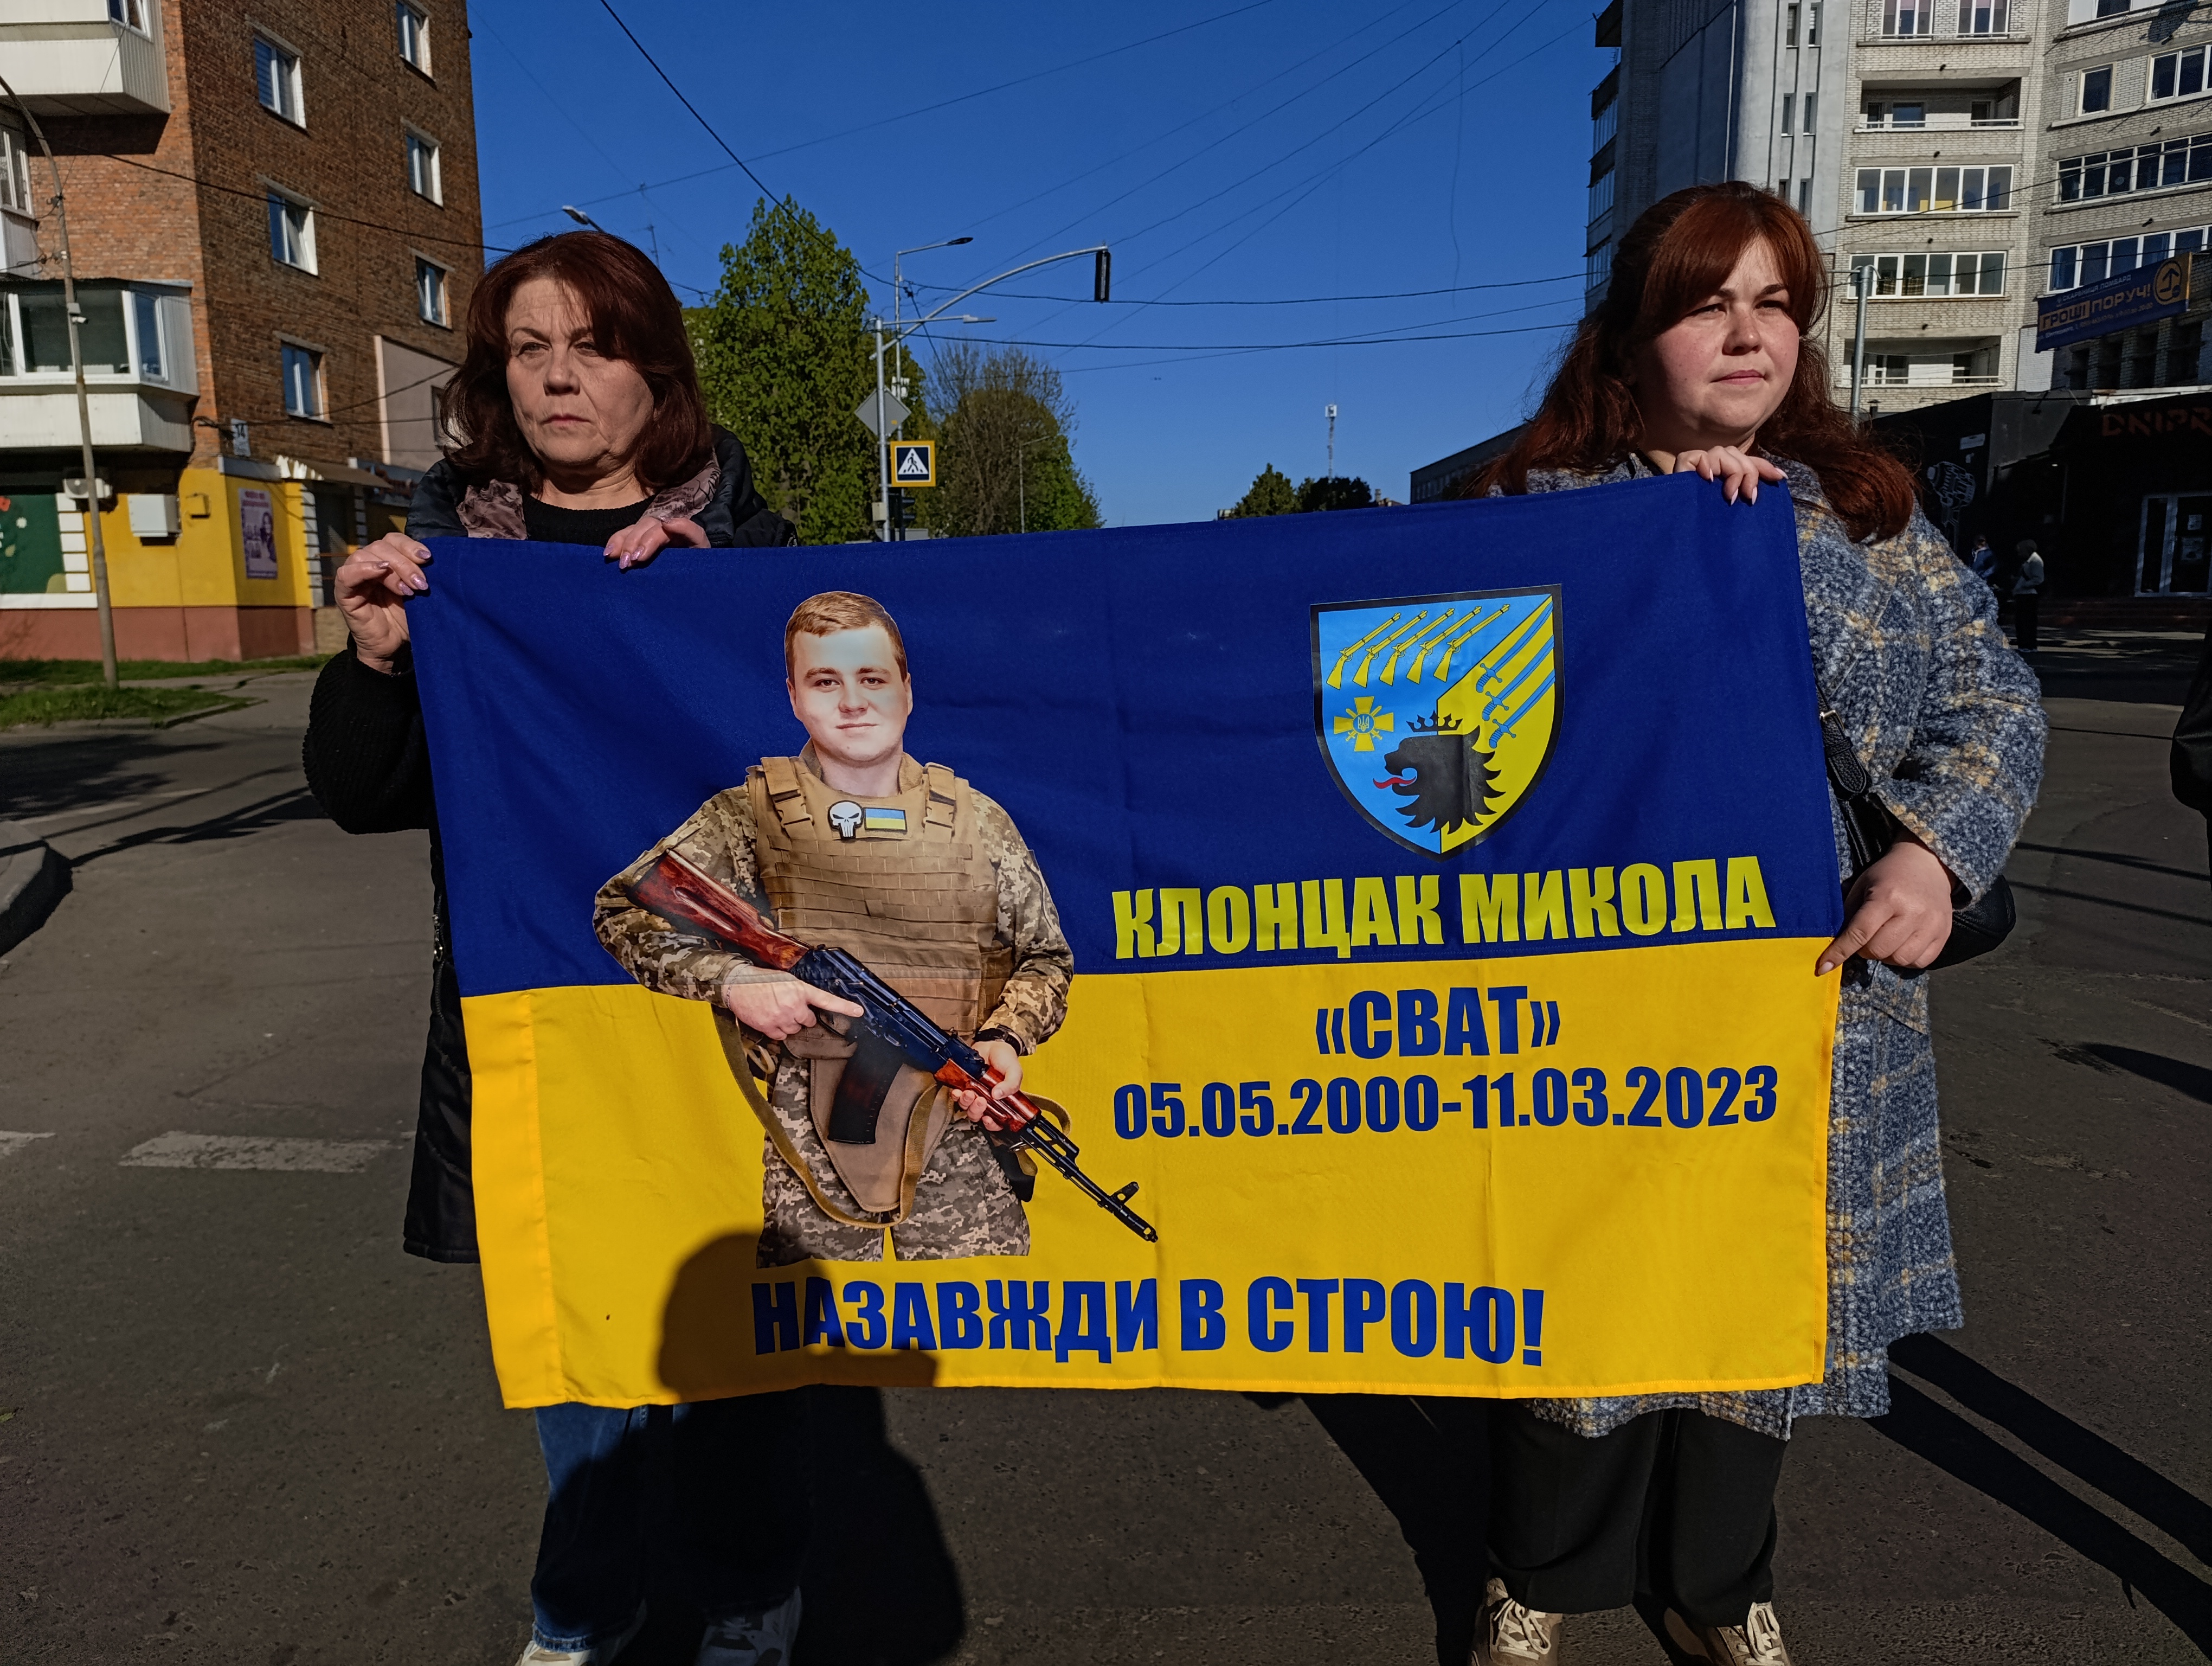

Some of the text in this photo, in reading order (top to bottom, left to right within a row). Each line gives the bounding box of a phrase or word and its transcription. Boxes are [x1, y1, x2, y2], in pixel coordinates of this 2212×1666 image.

[2043, 304, 2086, 329] ГРОШІ
[2091, 283, 2151, 313] ПОРУЧ!
[1113, 856, 1776, 959] КЛОНЦАК МИКОЛА
[1316, 986, 1560, 1059] «СВАТ»
[1114, 1066, 1777, 1139] 05.05.2000-11.03.2023
[753, 1276, 1544, 1367] НАЗАВЖДИ В СТРОЮ!
